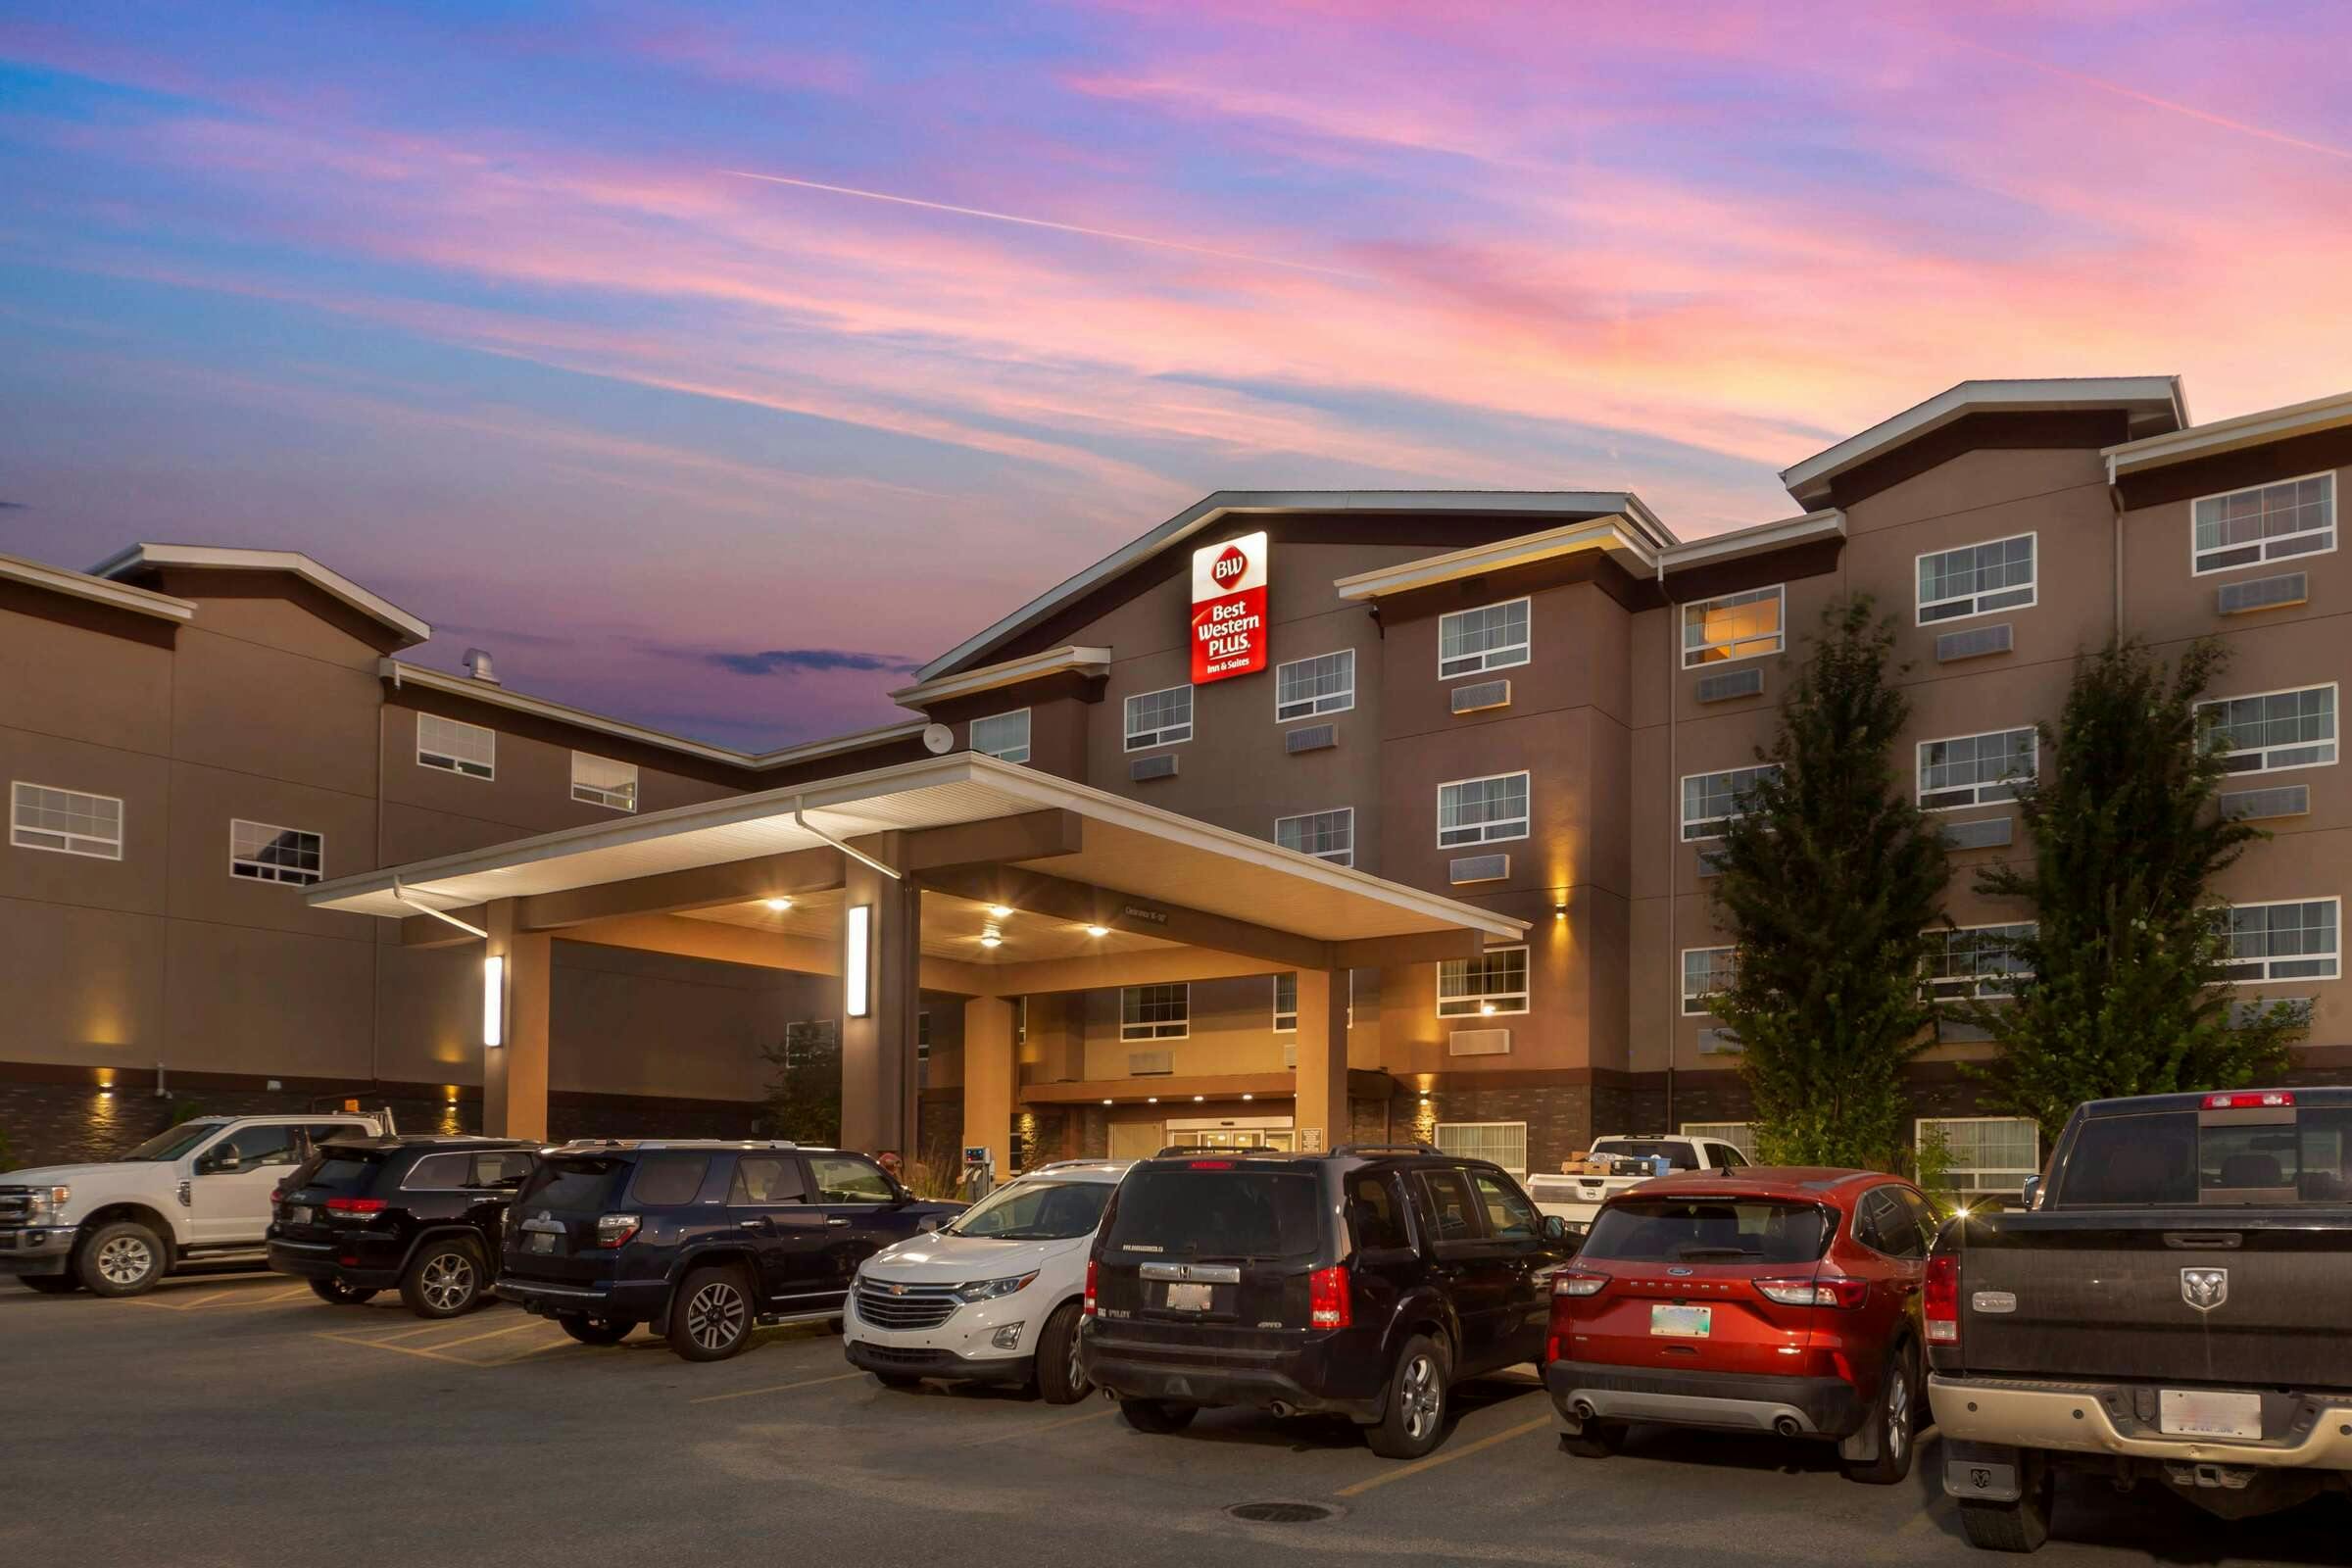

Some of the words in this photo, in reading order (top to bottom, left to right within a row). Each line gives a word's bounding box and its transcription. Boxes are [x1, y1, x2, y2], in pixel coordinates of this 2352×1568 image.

[1215, 556, 1243, 579] BW
[1212, 601, 1247, 621] Best
[1198, 614, 1260, 642] Western
[1206, 664, 1220, 674] Inn
[1220, 662, 1227, 670] &
[1227, 658, 1250, 669] Suites
